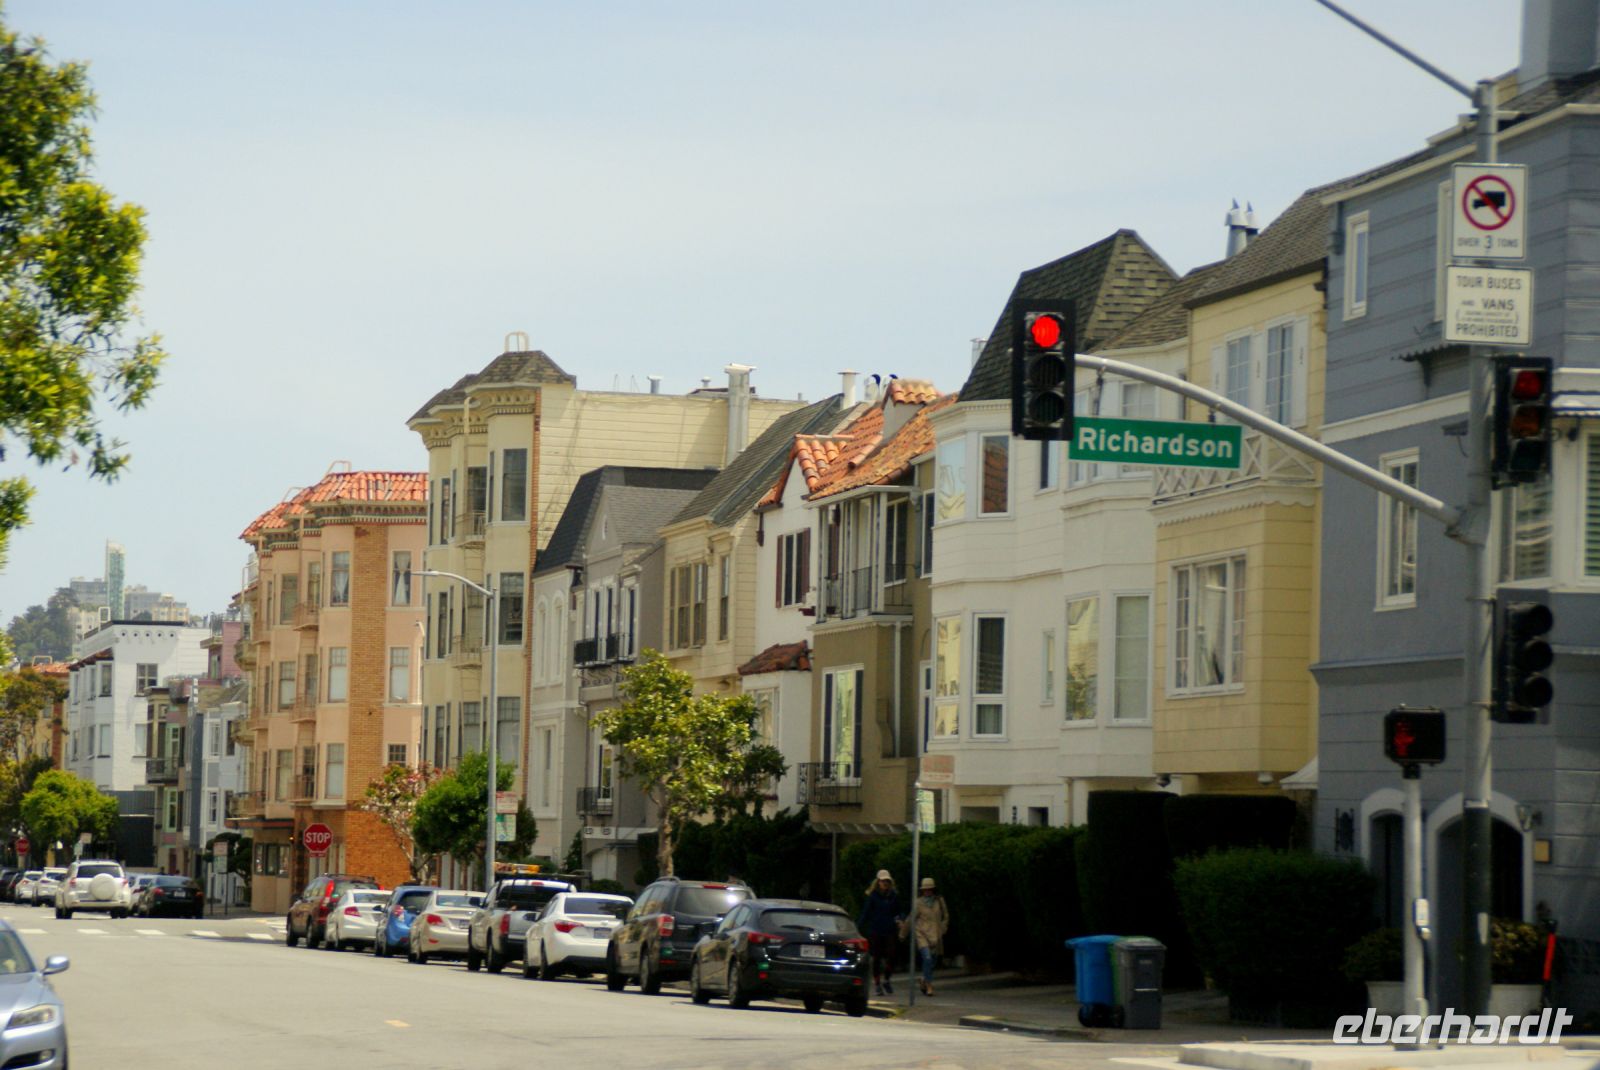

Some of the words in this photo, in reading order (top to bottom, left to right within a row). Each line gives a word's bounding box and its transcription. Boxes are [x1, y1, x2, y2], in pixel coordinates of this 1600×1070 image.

[1484, 234, 1492, 249] 3
[1456, 275, 1483, 288] TOUR
[1487, 276, 1521, 290] BUSES
[1482, 298, 1514, 311] VANS
[1456, 323, 1518, 337] PROHIBITED
[1078, 427, 1233, 458] Richardson
[305, 832, 331, 843] STOP
